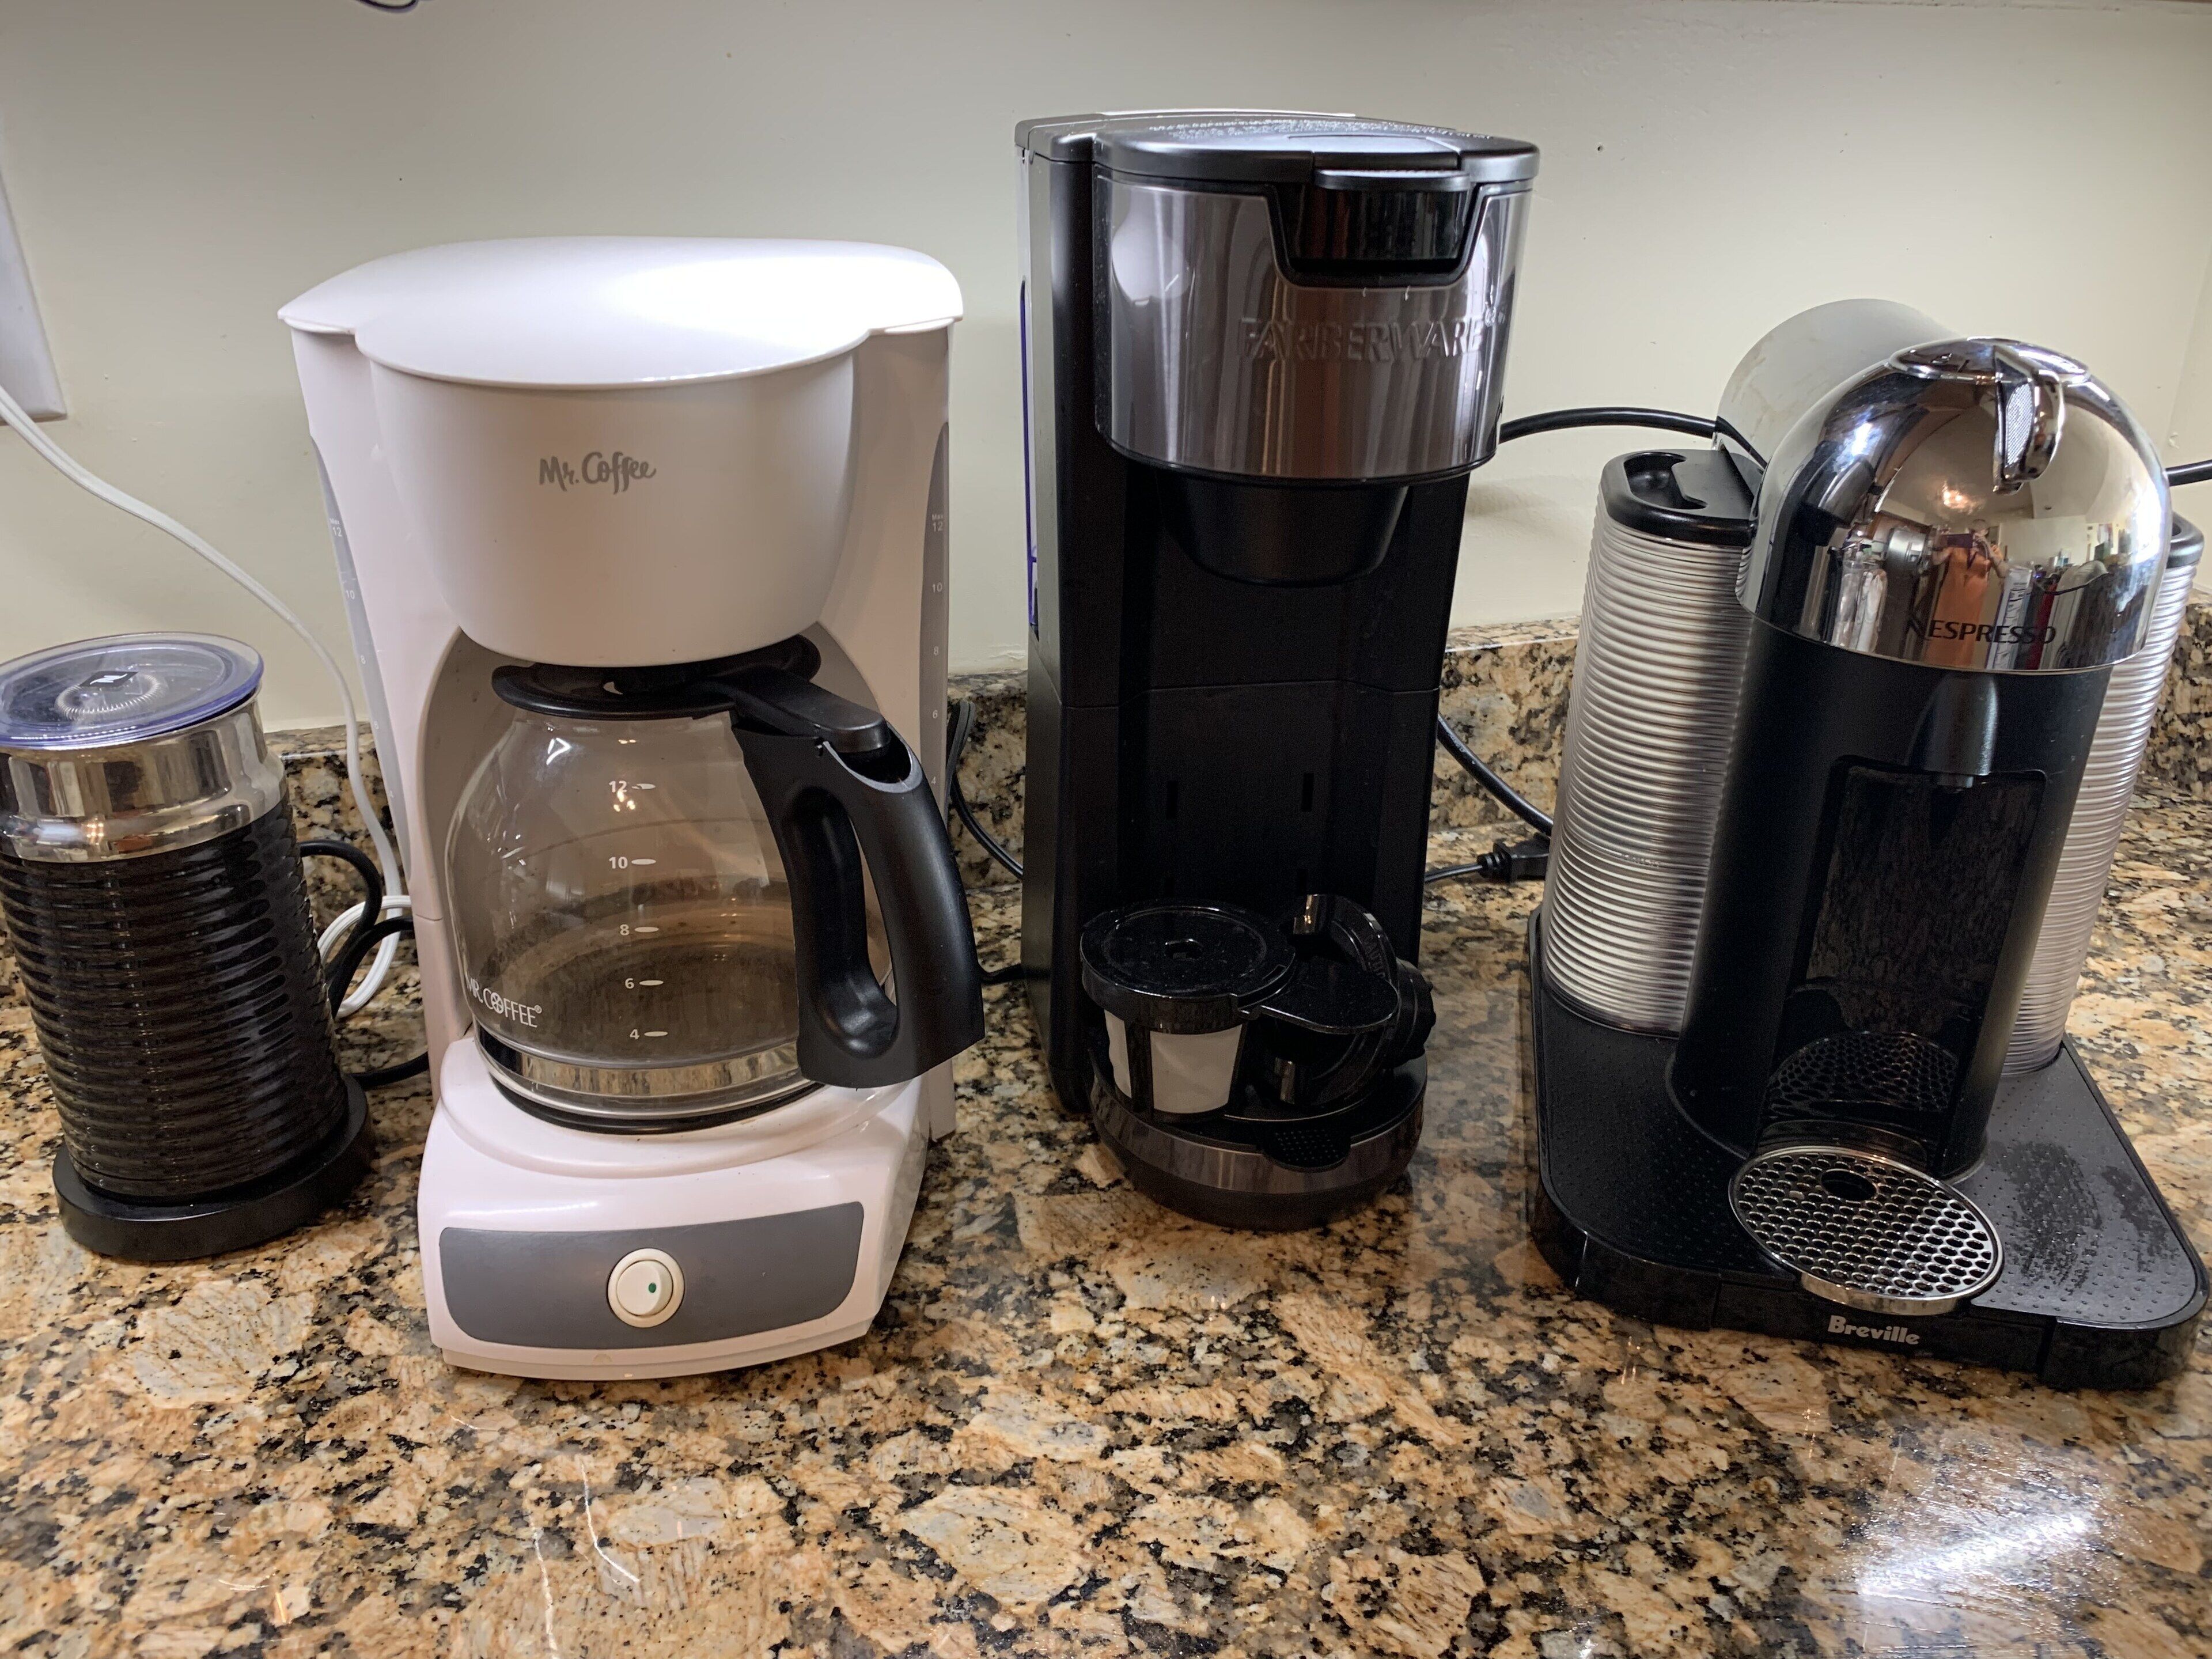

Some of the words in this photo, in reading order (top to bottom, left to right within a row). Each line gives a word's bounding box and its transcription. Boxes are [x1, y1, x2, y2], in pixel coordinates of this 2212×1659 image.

[539, 456, 579, 492] Mr.
[581, 452, 656, 495] Coffee
[332, 527, 342, 537] 12
[933, 521, 943, 532] 12
[932, 582, 942, 593] 10
[346, 590, 355, 600] 10
[1906, 619, 2057, 644] NESPRESSO
[934, 647, 939, 656] 8
[360, 655, 366, 664] 8
[932, 710, 938, 719] 6
[608, 781, 627, 793] 12
[931, 777, 937, 786] 4
[608, 856, 628, 869] 10
[620, 924, 630, 935] 8
[625, 978, 635, 989] 6
[630, 1029, 640, 1040] 4
[1827, 1315, 1921, 1345] Breville
